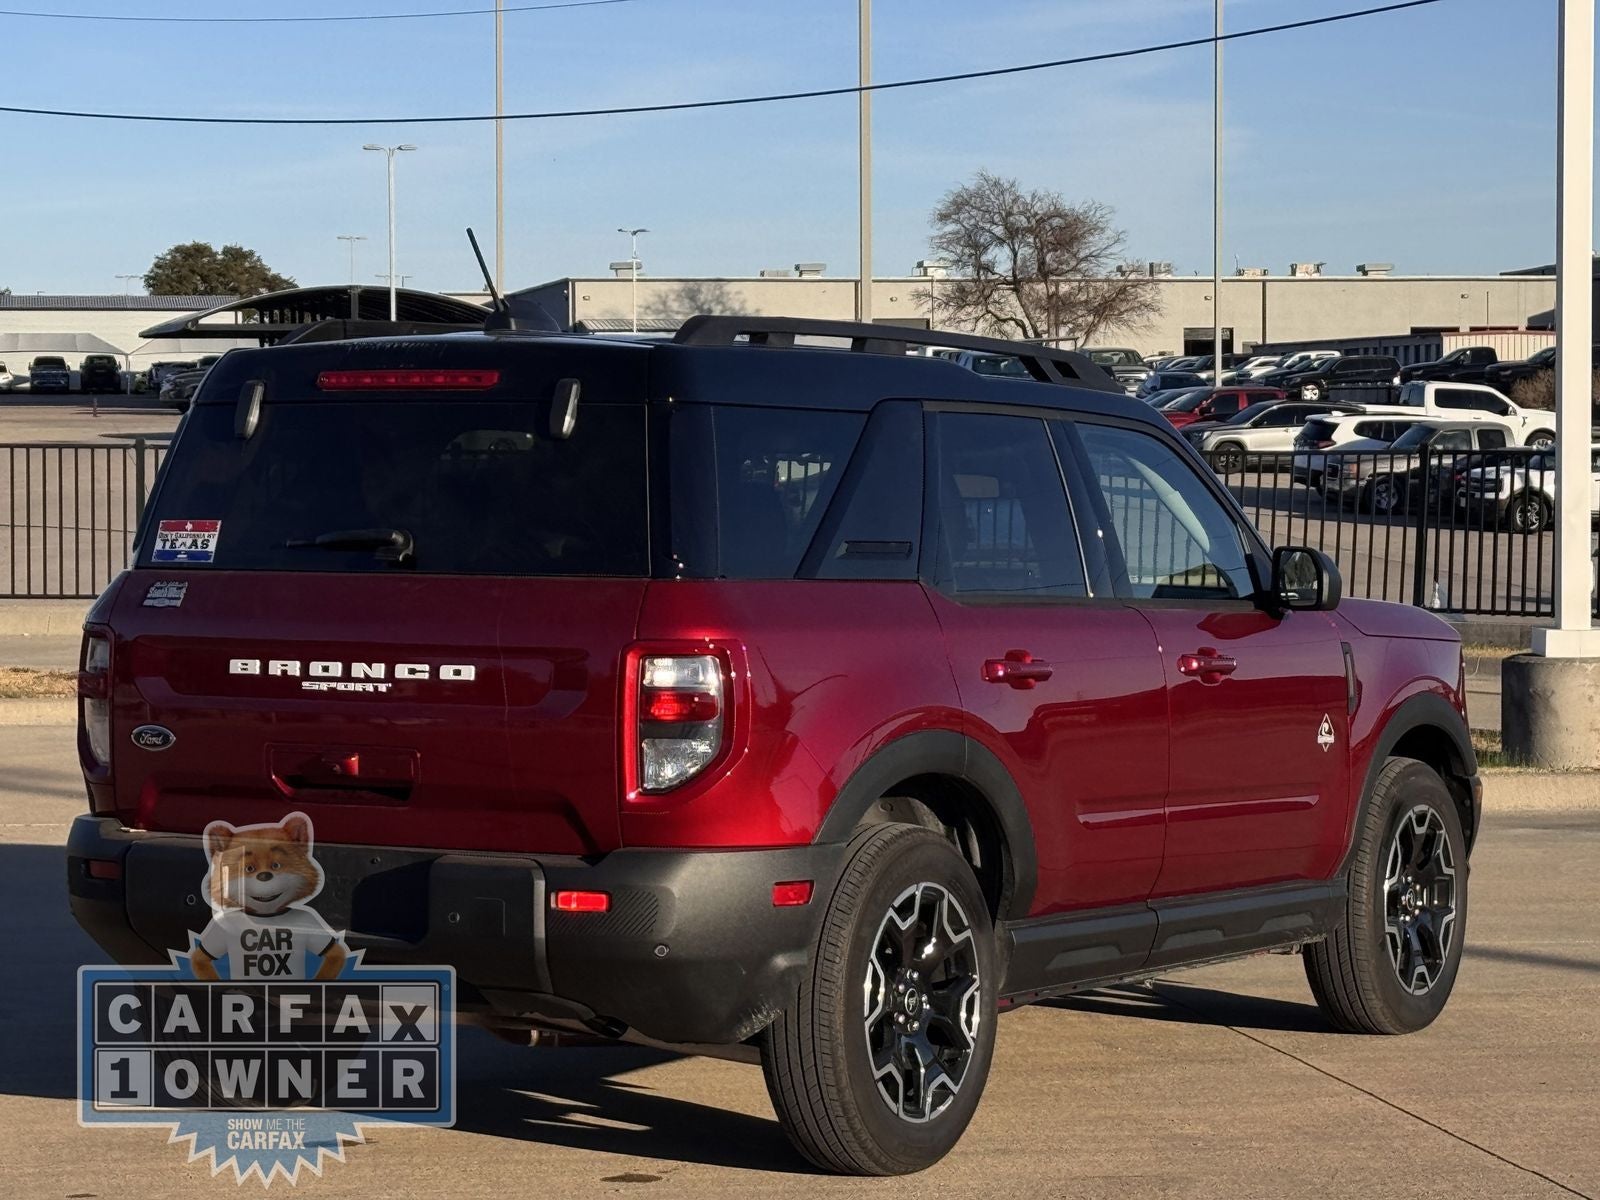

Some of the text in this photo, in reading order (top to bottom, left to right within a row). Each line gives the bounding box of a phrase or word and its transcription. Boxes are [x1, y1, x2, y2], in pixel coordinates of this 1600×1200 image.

[229, 659, 476, 681] BRONCO
[302, 681, 389, 692] SPORT
[139, 729, 164, 745] Ford
